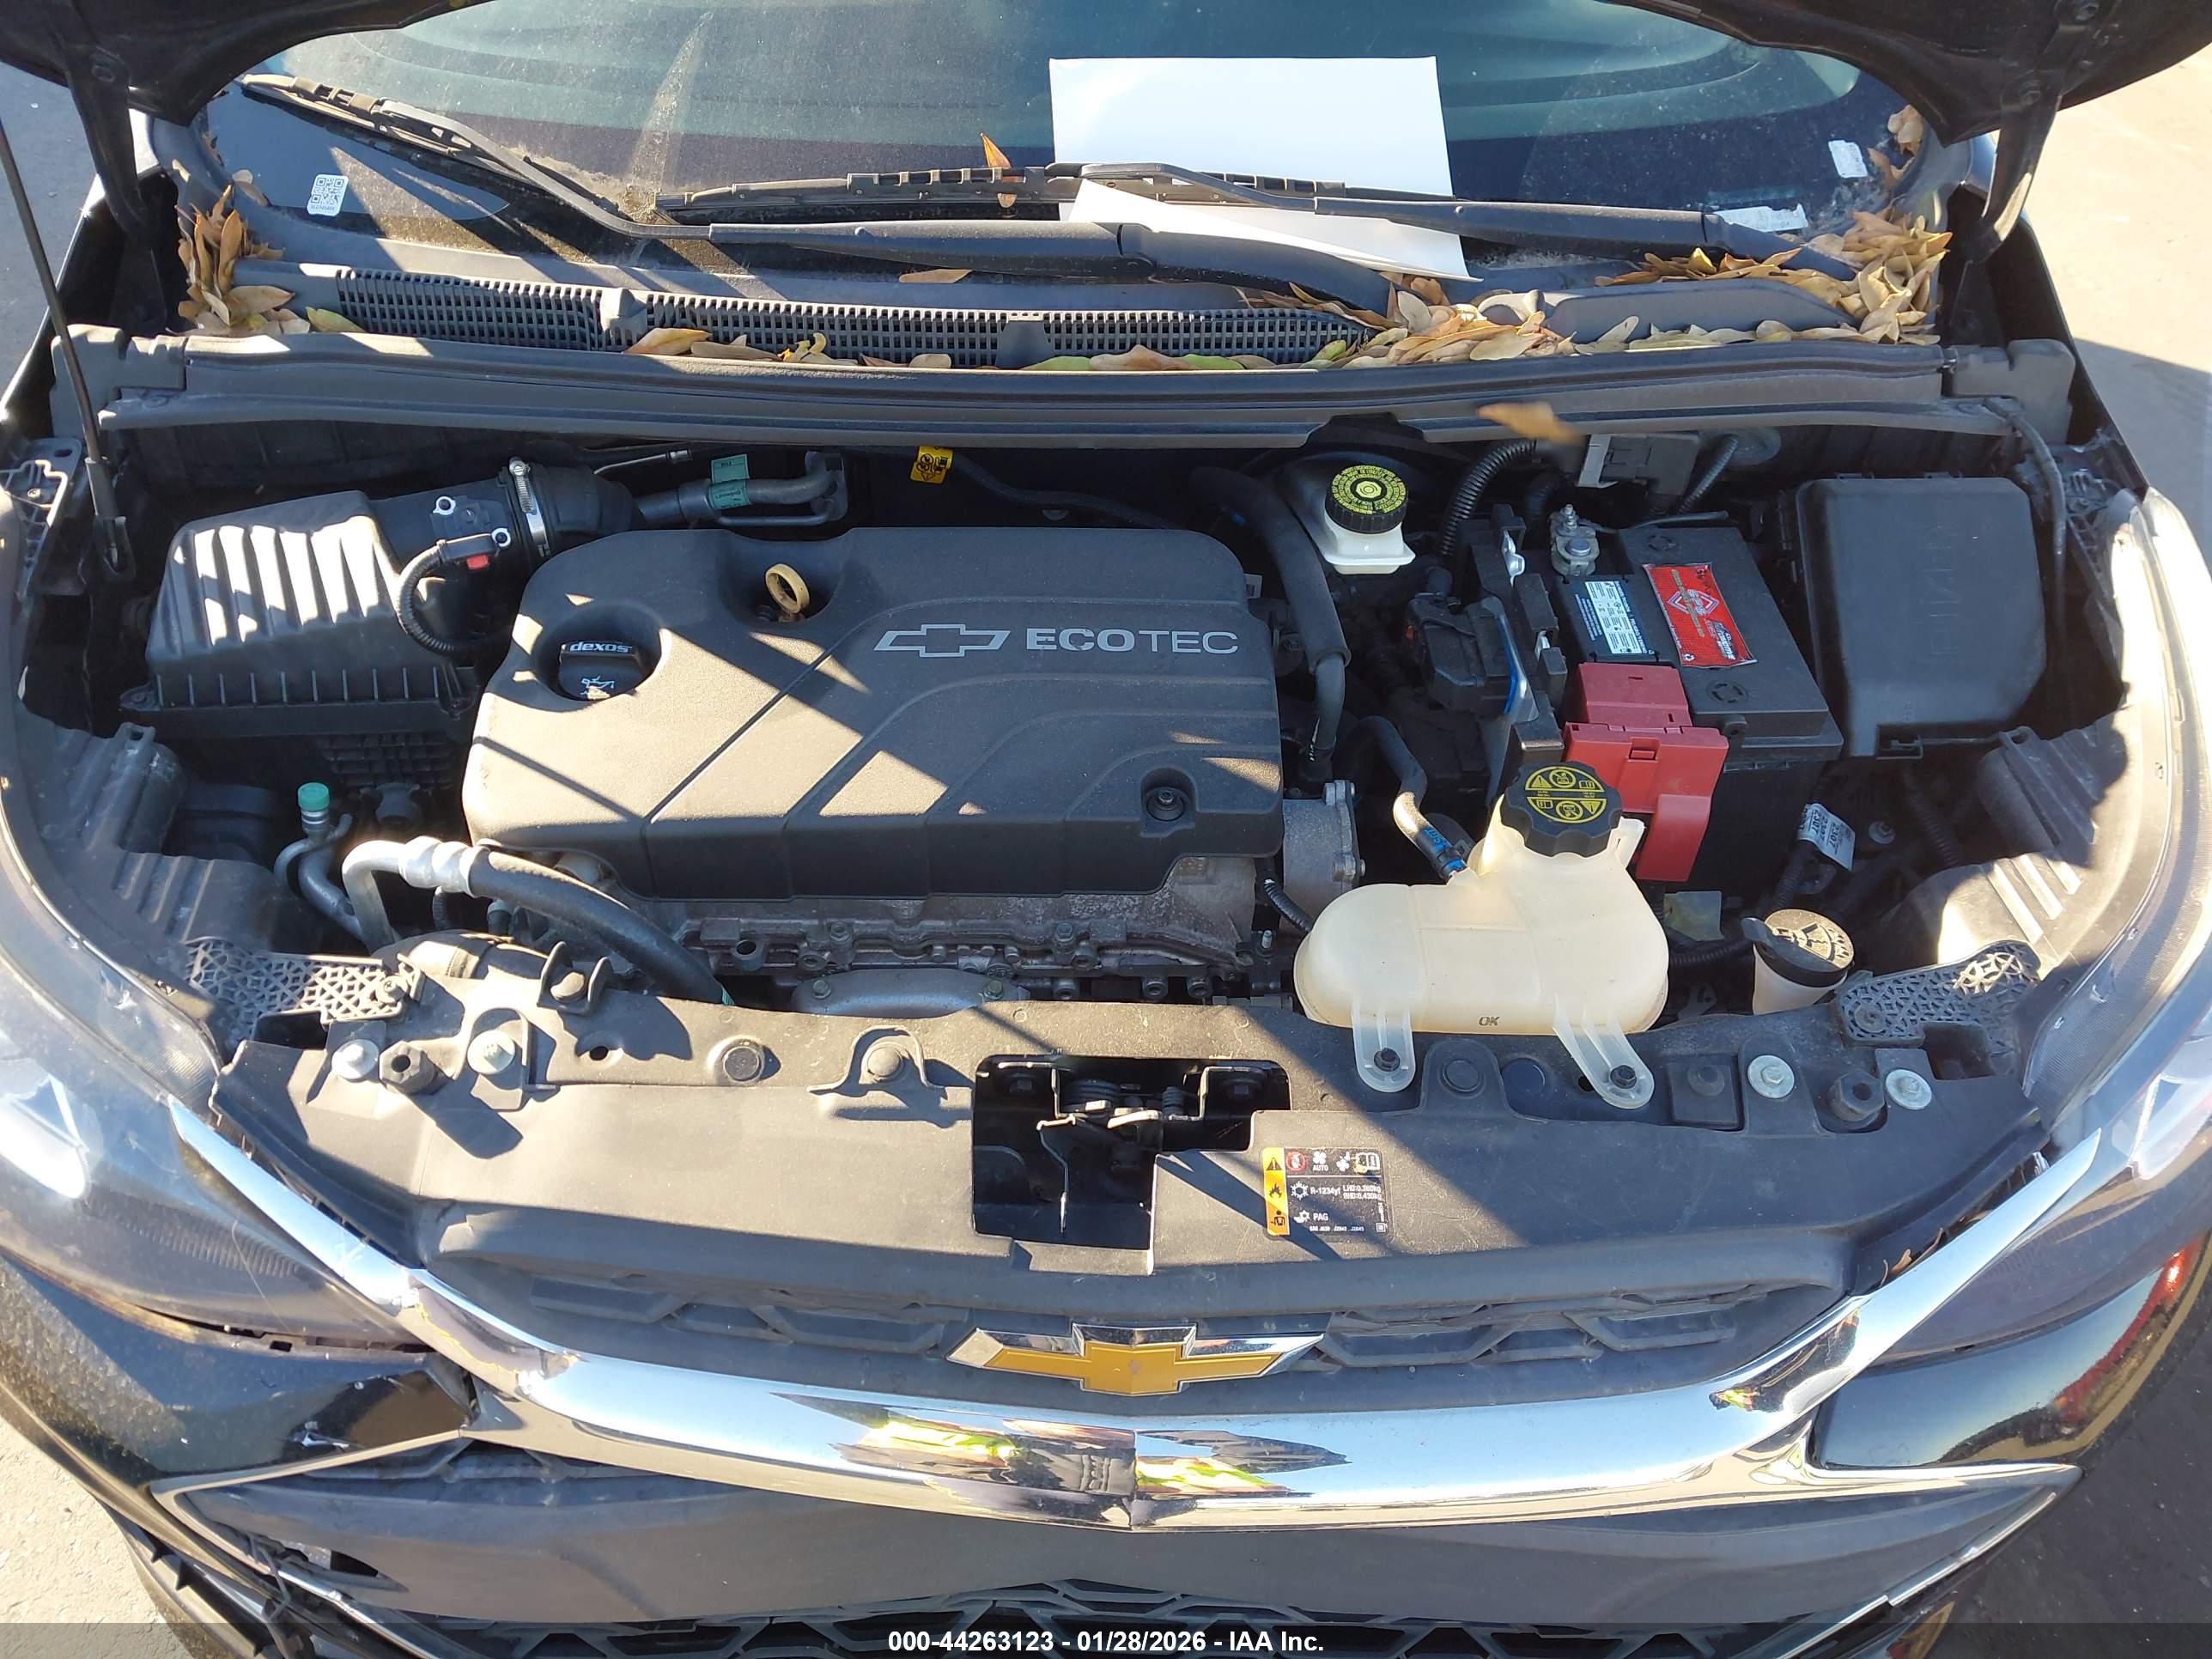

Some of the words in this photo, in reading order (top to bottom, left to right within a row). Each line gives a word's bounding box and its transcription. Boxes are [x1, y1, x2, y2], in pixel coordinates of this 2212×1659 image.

[1026, 628, 1239, 654] ECOTEC
[569, 641, 632, 653] dexos
[1829, 822, 1838, 848] 2307
[1478, 1016, 1501, 1027] OK
[1310, 1186, 1341, 1196] R-1234yf
[1313, 1212, 1329, 1222] PAG
